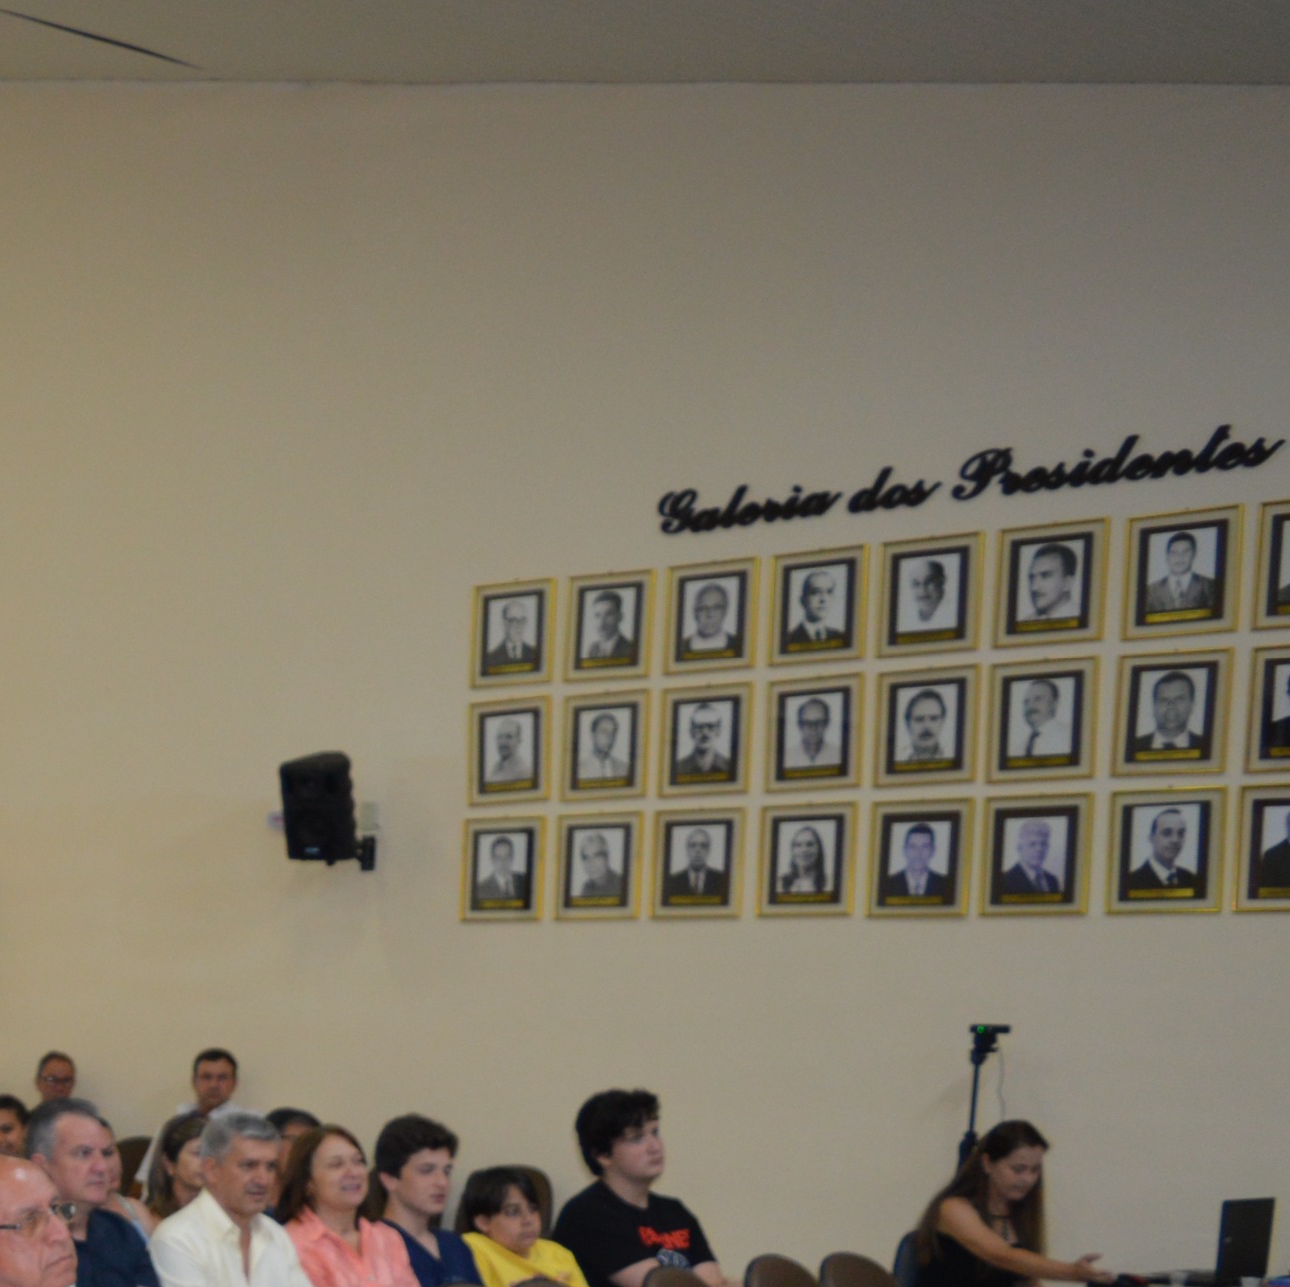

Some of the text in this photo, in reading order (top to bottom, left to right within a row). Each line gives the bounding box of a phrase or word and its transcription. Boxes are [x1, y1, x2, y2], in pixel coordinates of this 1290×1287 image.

[658, 424, 1285, 534] Galeria dos Presidentes
